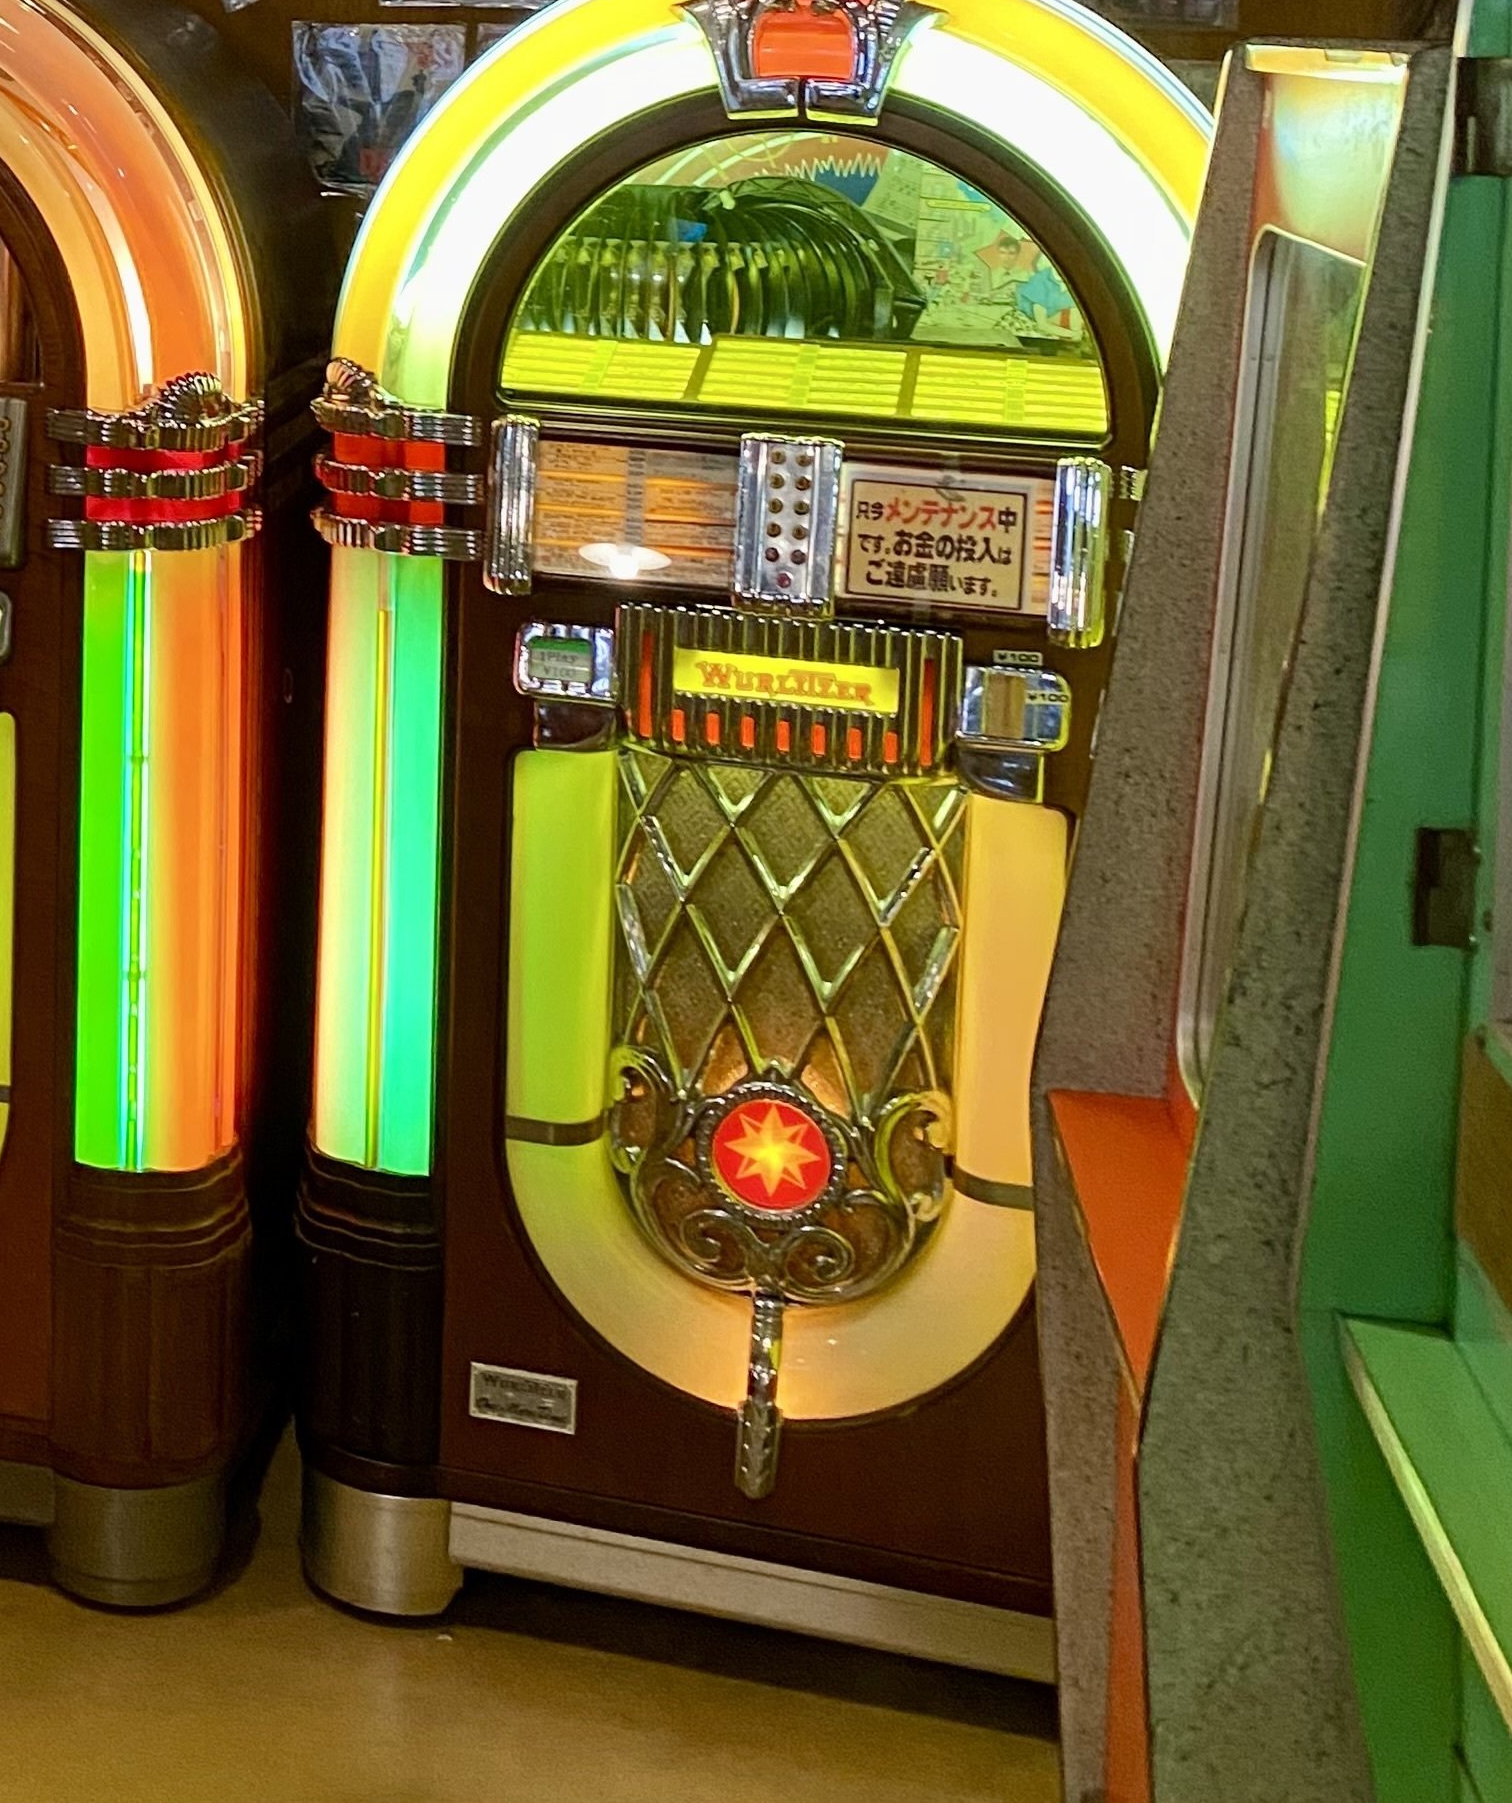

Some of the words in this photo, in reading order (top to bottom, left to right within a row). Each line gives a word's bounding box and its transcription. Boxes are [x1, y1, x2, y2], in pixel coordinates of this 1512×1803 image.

[857, 496, 1018, 534] 只今メンテナンス中
[998, 652, 1040, 664] ¥100
[1027, 692, 1070, 703] ¥100
